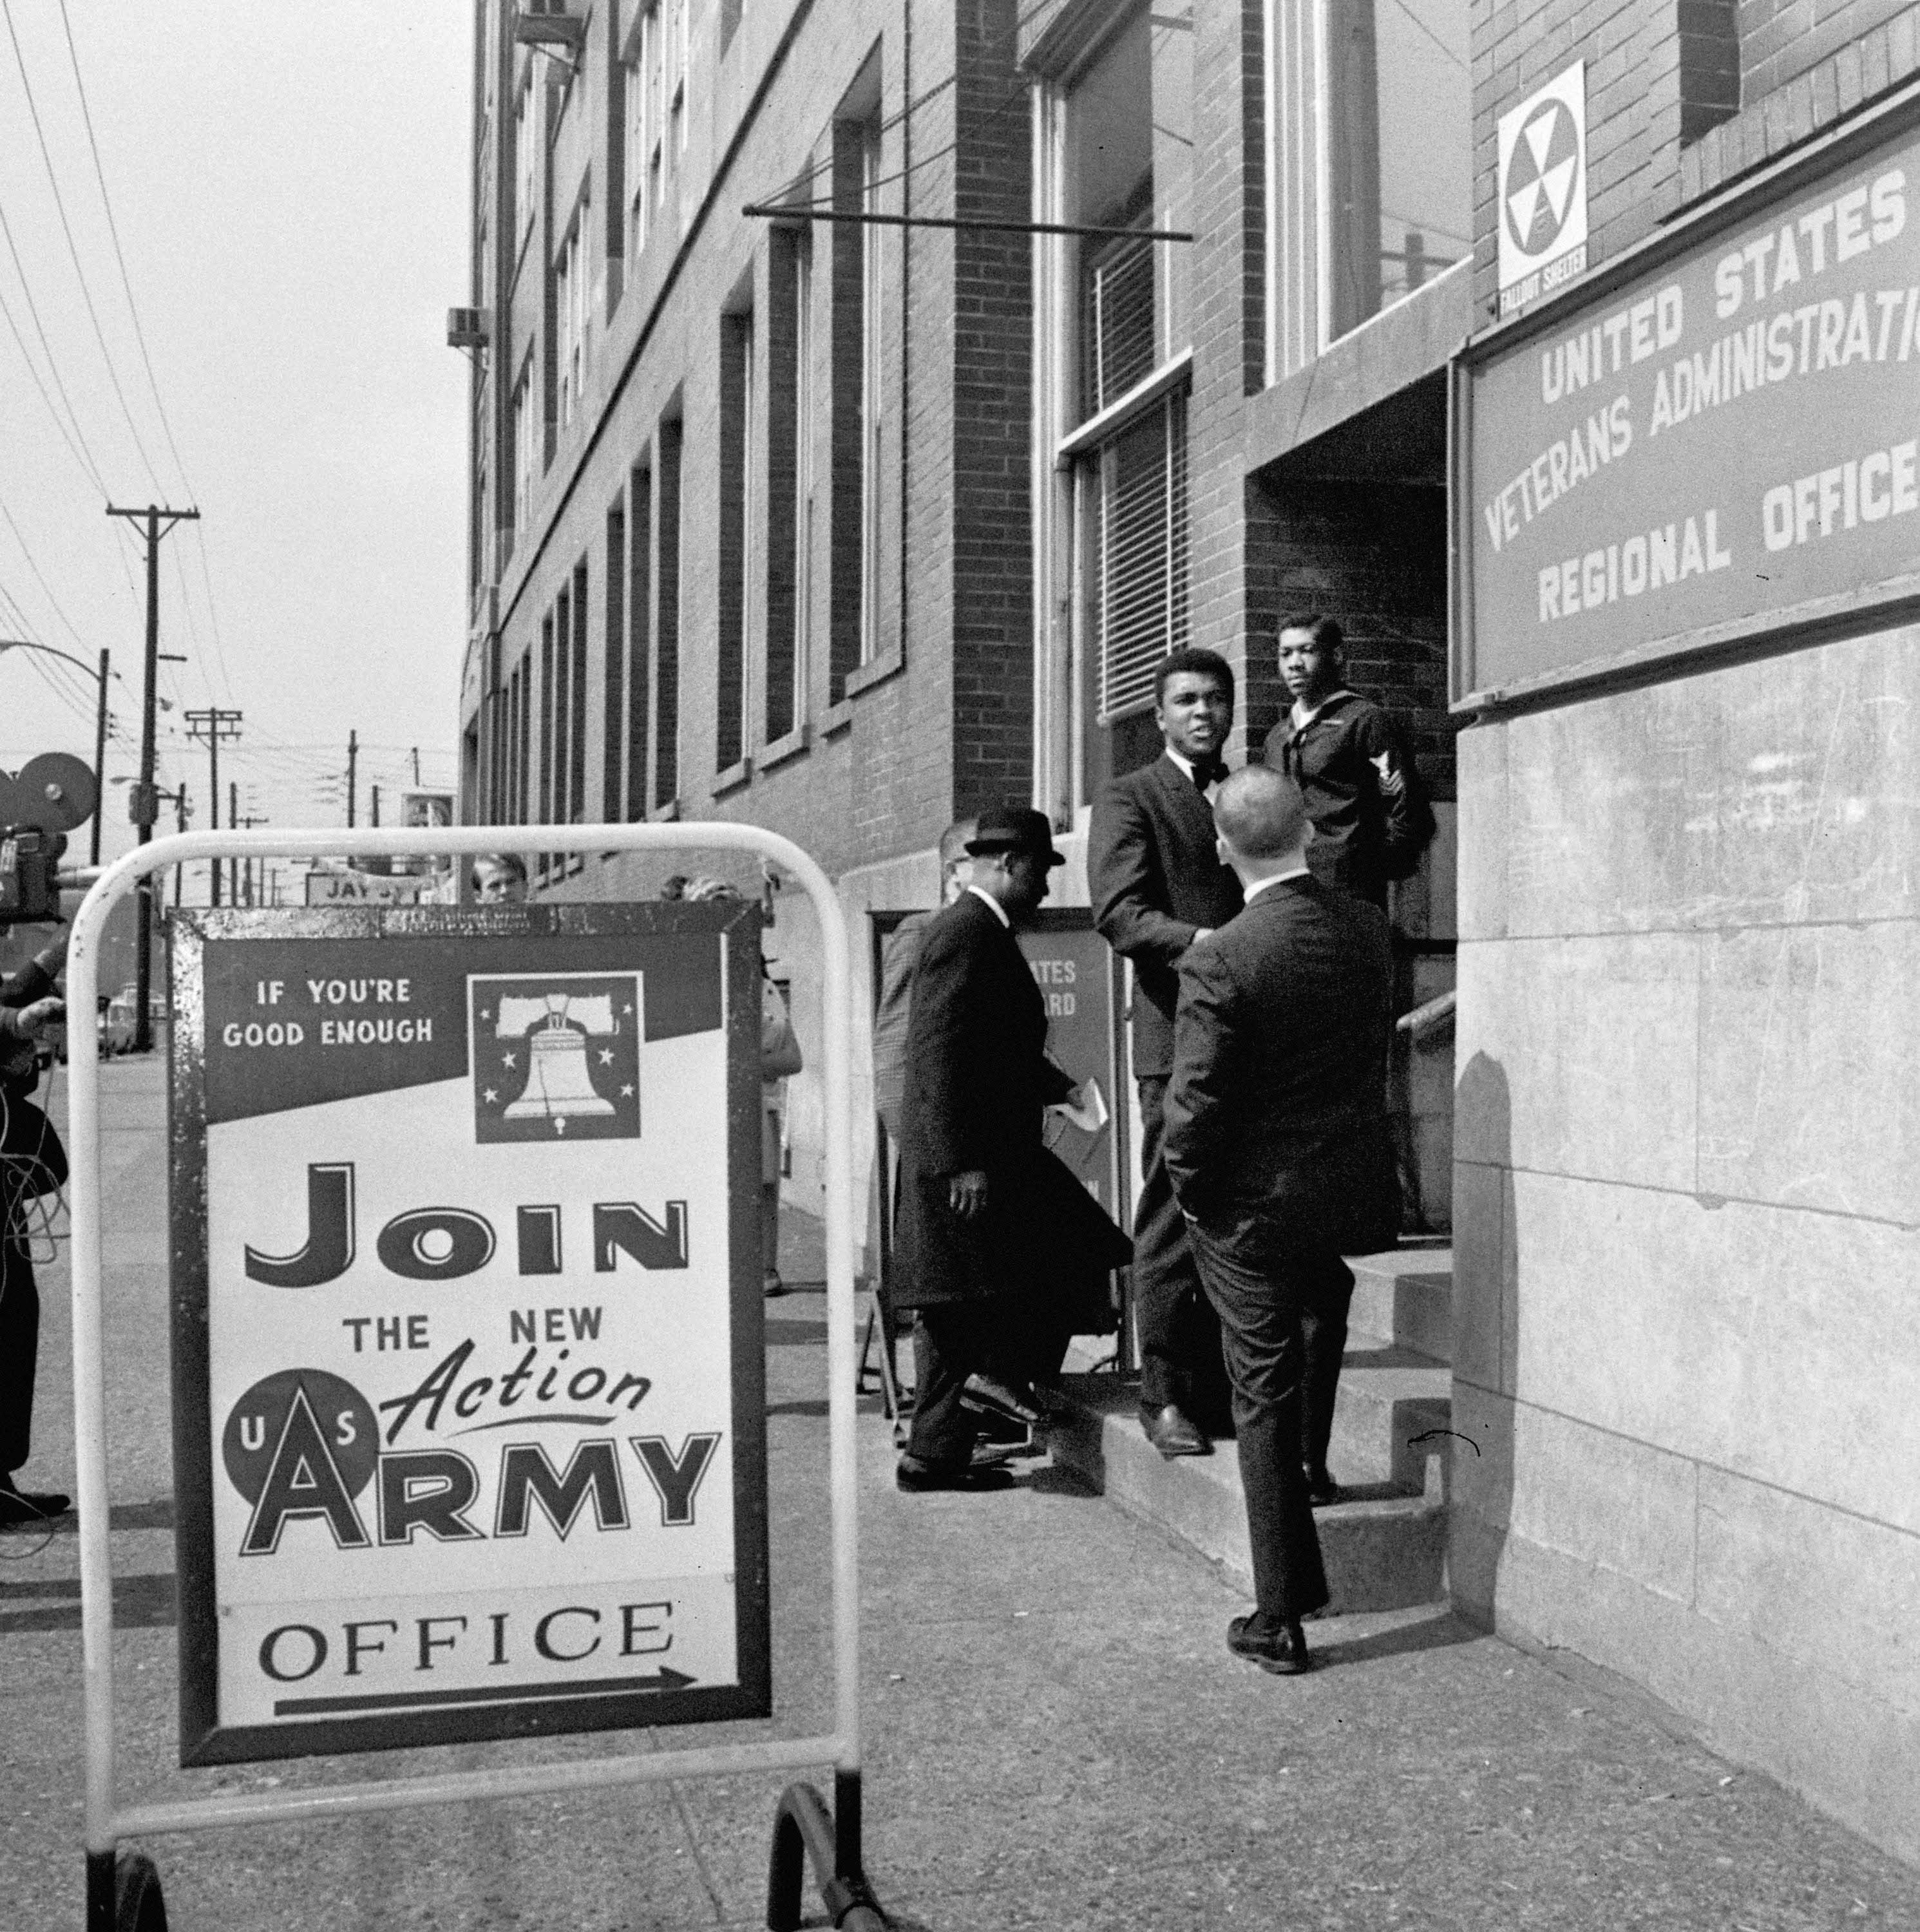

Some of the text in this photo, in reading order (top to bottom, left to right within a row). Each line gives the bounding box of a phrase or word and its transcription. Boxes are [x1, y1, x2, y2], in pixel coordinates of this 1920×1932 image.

[1542, 169, 1906, 404] UNITED STATES
[1485, 288, 1920, 552] VETERANS ADMINISTRATI
[1538, 439, 1919, 623] REGIONAL OFFICE
[223, 1018, 433, 1047] GOOD ENOUGH
[258, 978, 412, 1005] IF YOU'RE
[244, 1161, 689, 1289] JOIN
[342, 1306, 604, 1353] THE NEW
[377, 1338, 652, 1446] Action
[239, 1384, 723, 1557] ARMY
[258, 1601, 674, 1682] OFFICE
